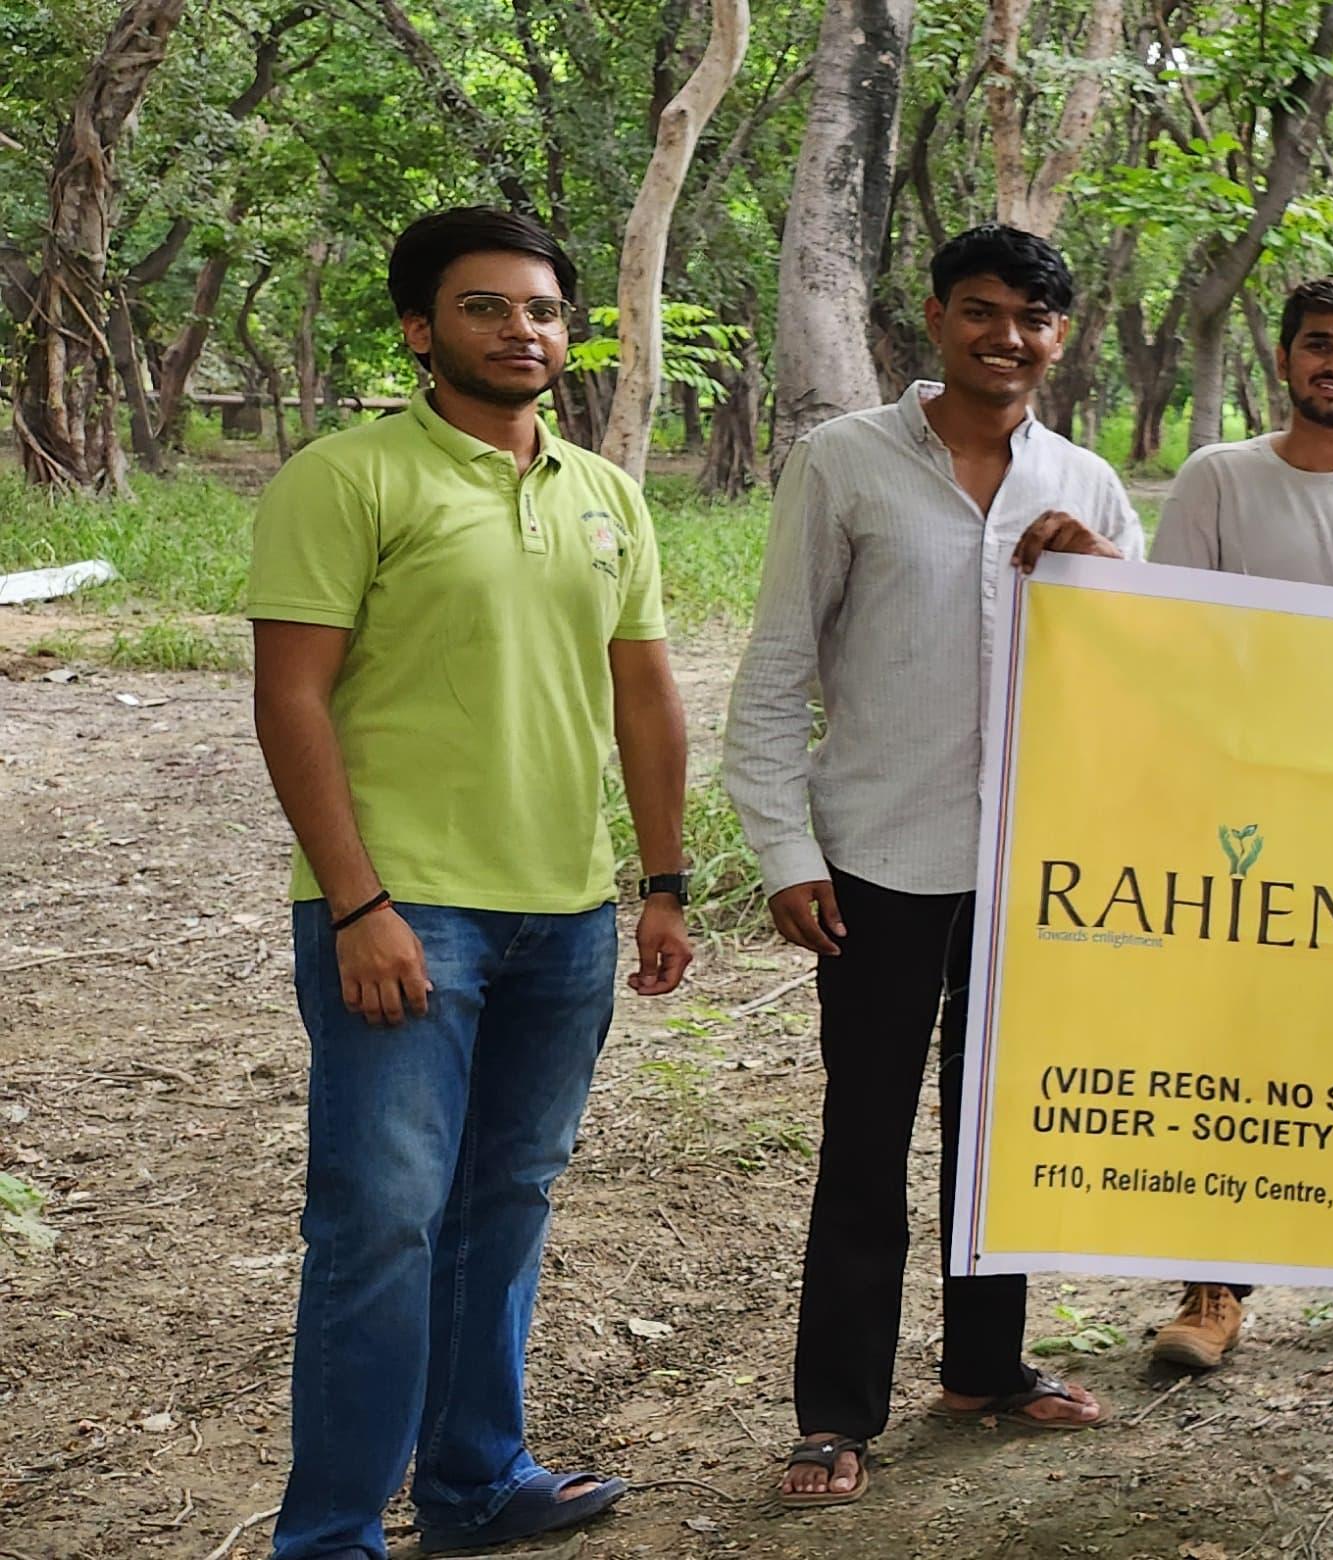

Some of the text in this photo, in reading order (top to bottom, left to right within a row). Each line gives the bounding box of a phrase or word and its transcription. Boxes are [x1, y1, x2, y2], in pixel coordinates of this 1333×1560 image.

[1036, 927, 1089, 943] Towards
[1041, 1066, 1136, 1099] (VIDE
[1149, 1071, 1252, 1104] REGN.
[1267, 1081, 1313, 1108] NO
[1033, 1106, 1155, 1137] UNDER
[1192, 1113, 1333, 1150] SOCIETY
[1033, 1164, 1091, 1193] Ff10,
[1102, 1168, 1196, 1195] Reliable
[1204, 1173, 1247, 1204] City
[1255, 1176, 1333, 1209] Centre,
